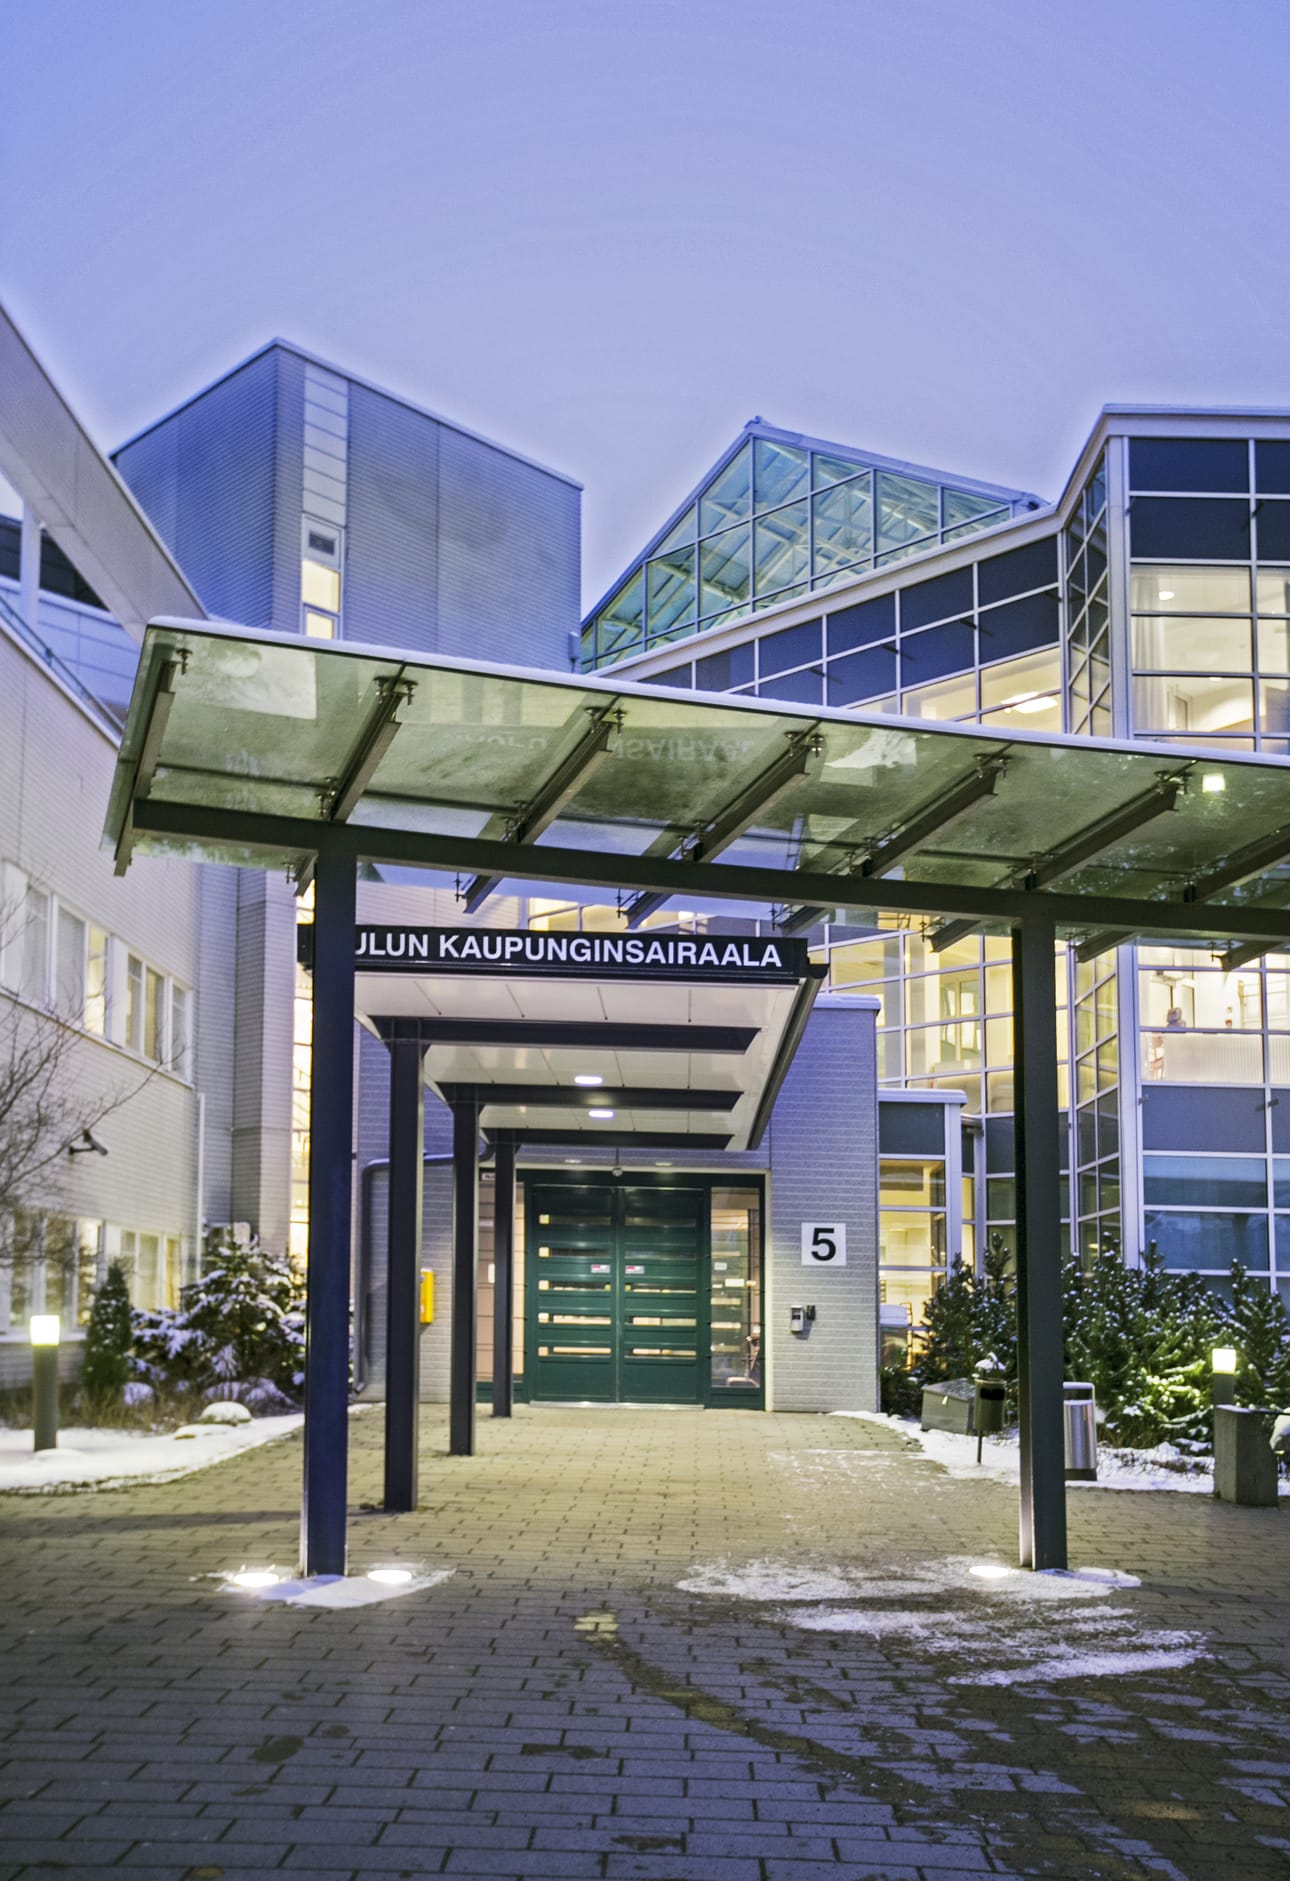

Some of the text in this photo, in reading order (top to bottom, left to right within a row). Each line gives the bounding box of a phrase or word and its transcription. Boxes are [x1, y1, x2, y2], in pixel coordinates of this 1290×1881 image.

[355, 932, 782, 967] ULUN KAUPUNGINSAIRAALA
[811, 1227, 836, 1262] 5
